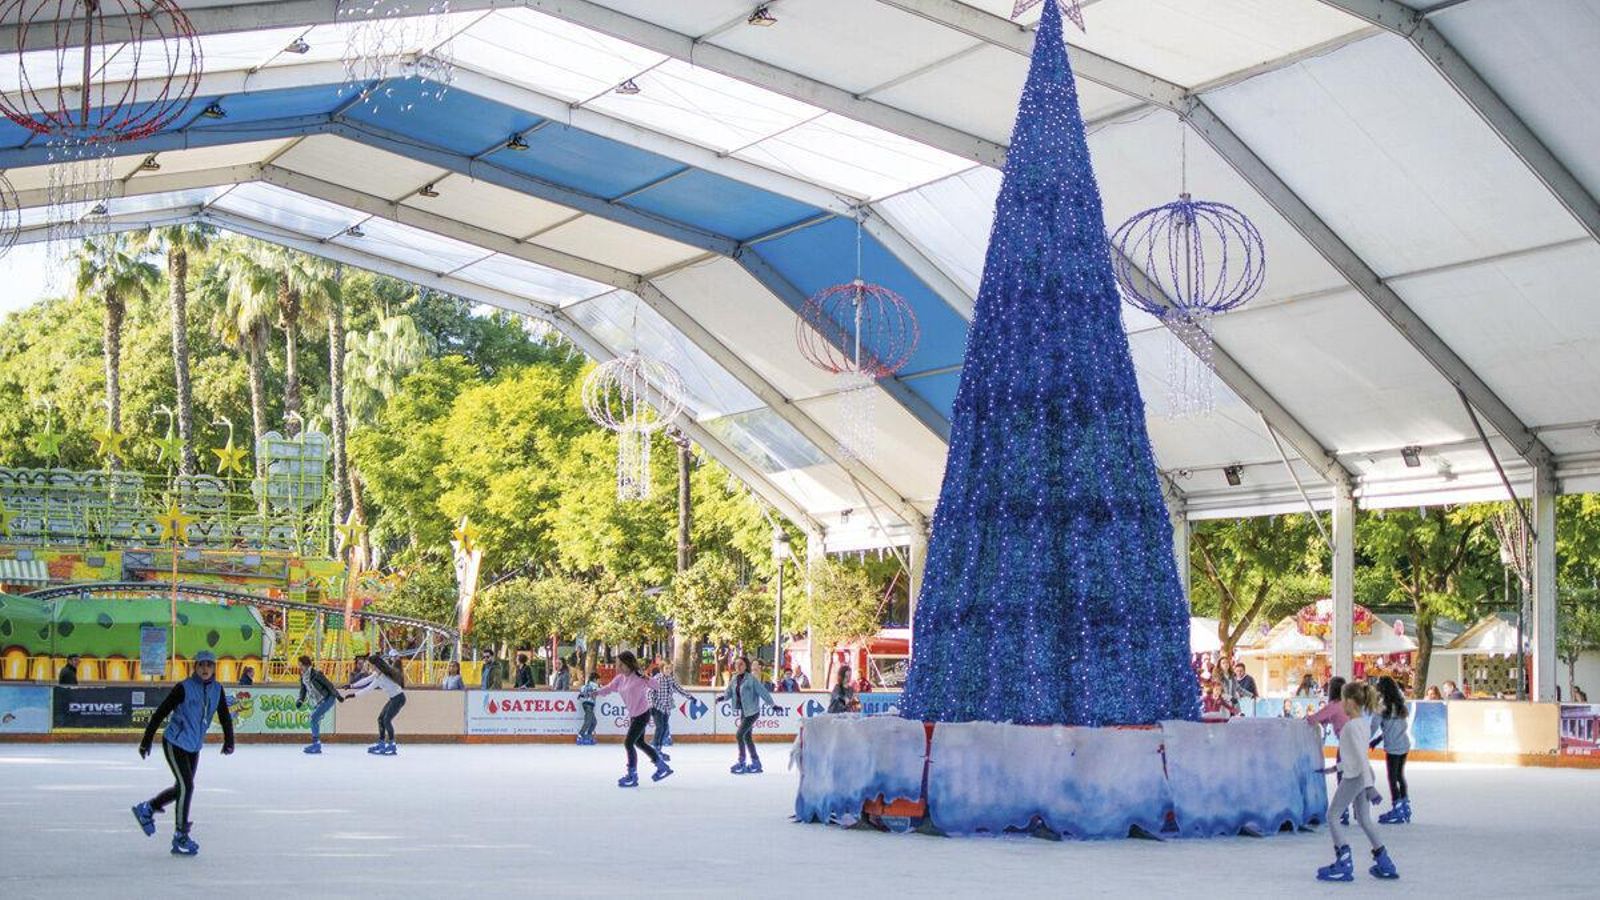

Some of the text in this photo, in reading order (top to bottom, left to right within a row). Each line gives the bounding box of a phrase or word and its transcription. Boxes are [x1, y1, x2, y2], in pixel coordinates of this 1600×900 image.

[502, 699, 577, 713] SATELCA
[721, 703, 791, 717] Cafour
[735, 718, 780, 729] Ceres
